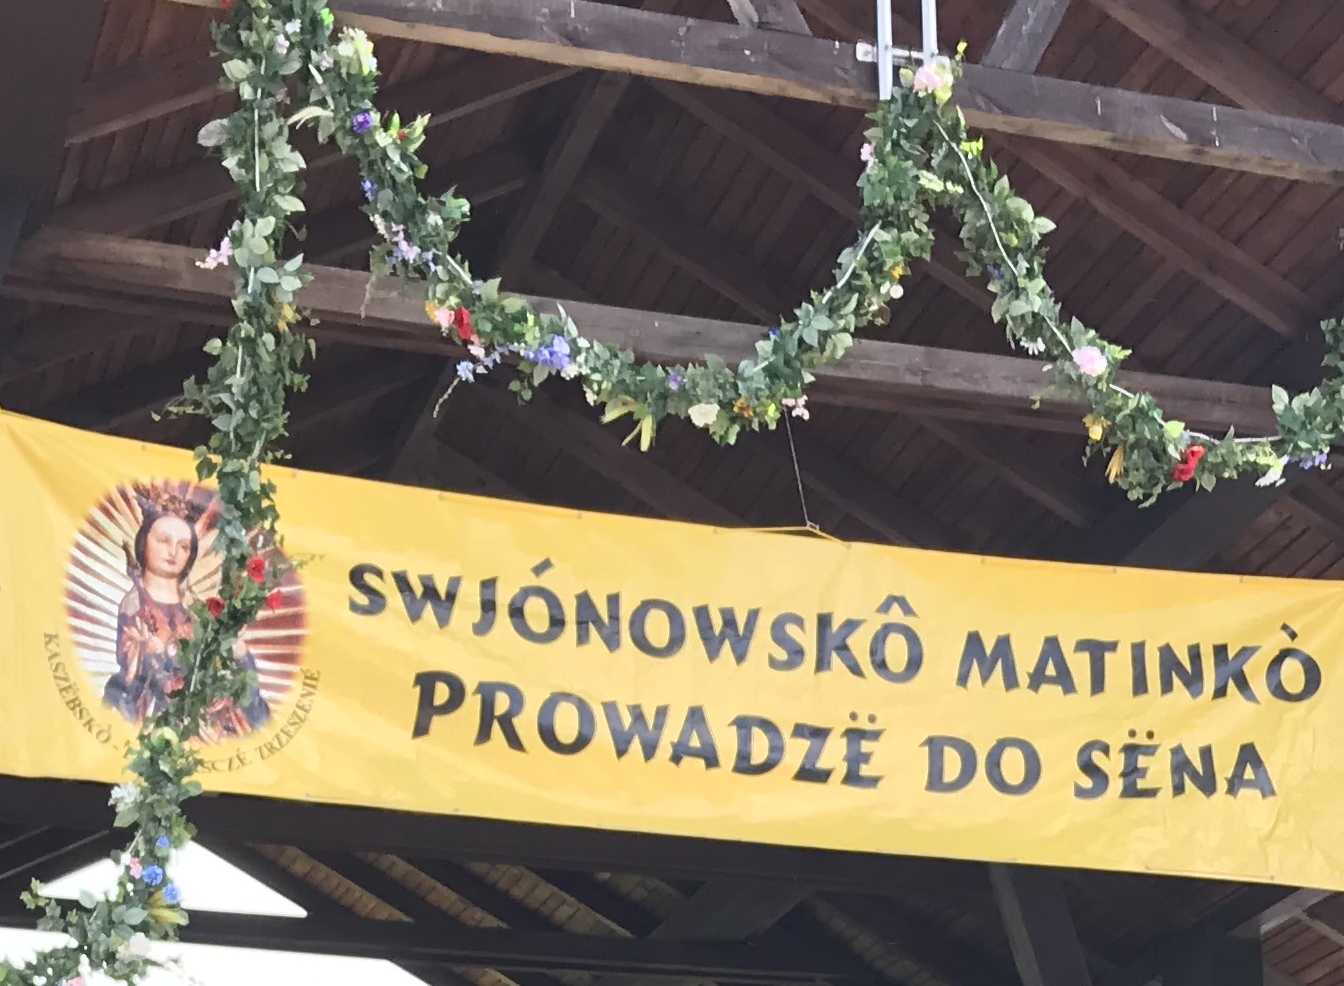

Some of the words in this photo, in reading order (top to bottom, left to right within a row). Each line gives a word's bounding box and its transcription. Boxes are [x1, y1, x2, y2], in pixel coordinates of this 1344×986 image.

[348, 558, 924, 683] SWJÓNOWSKÔ
[956, 622, 1322, 704] MATINKÒ
[411, 671, 887, 789] PROWADZË
[920, 735, 1042, 796] DO
[1073, 729, 1276, 800] SËNA
